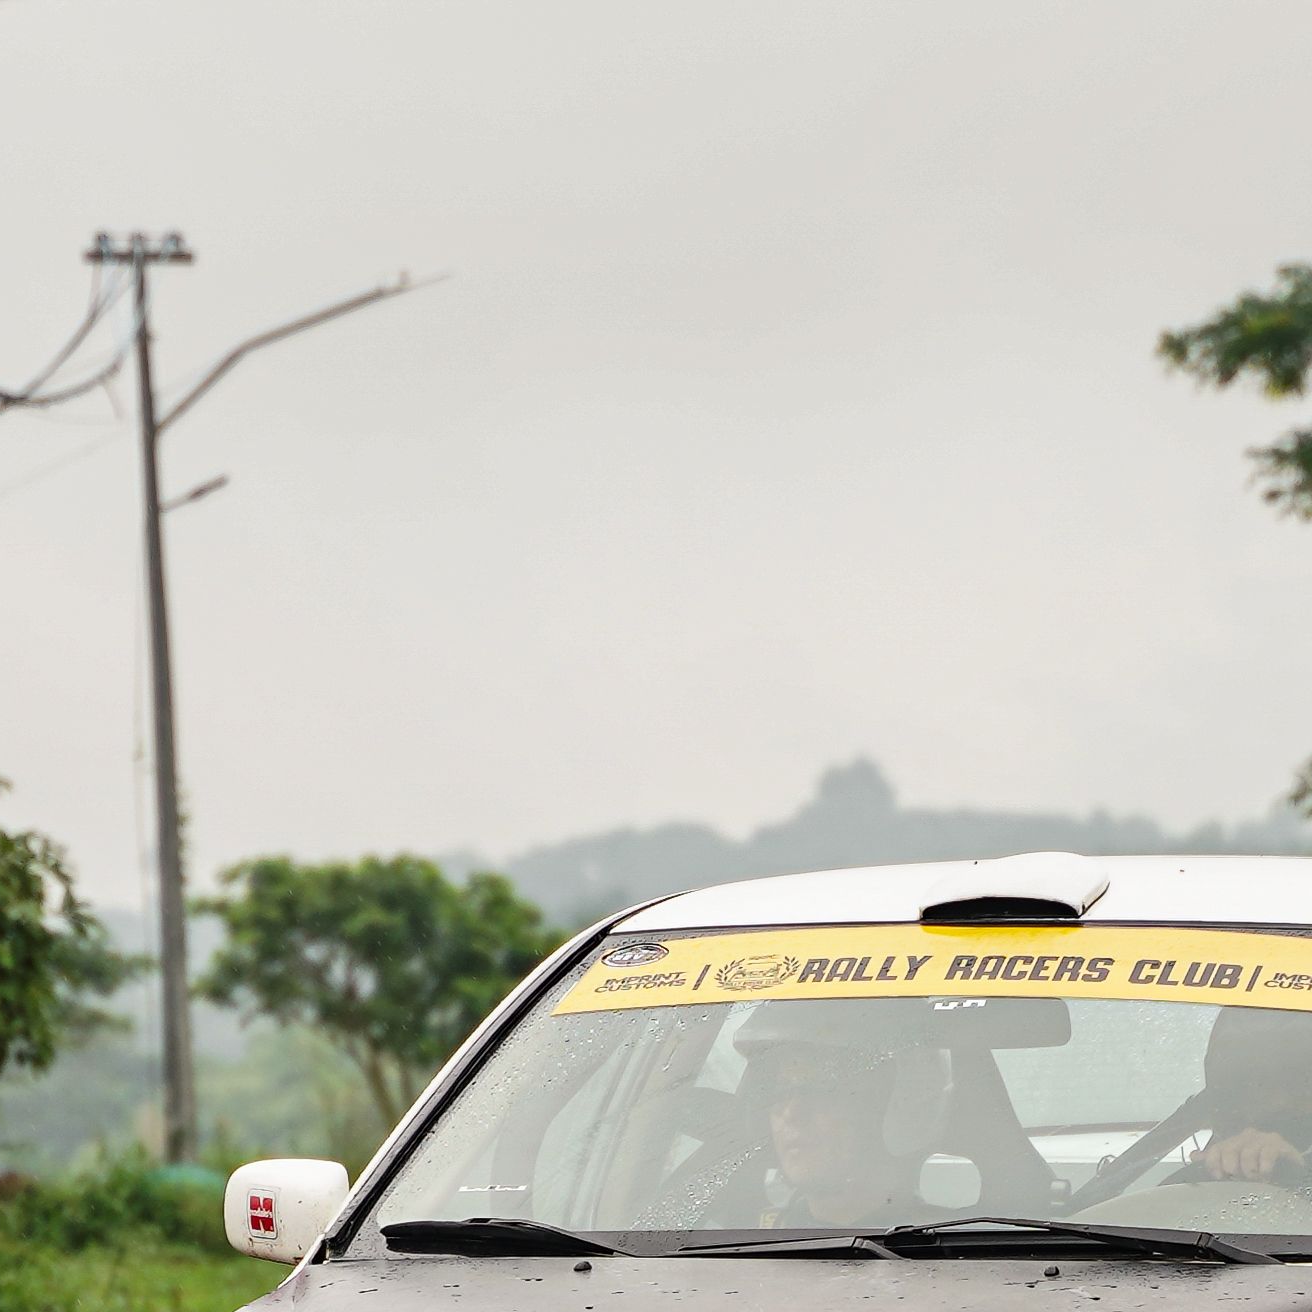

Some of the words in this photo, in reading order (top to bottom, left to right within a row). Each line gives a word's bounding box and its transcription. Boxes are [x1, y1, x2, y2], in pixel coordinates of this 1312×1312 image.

[602, 971, 687, 986] IMPRINT
[798, 955, 934, 983] RALLY
[944, 956, 1114, 982] RACERS
[1128, 960, 1241, 989] CLUB
[594, 979, 686, 993] CUSTOMS
